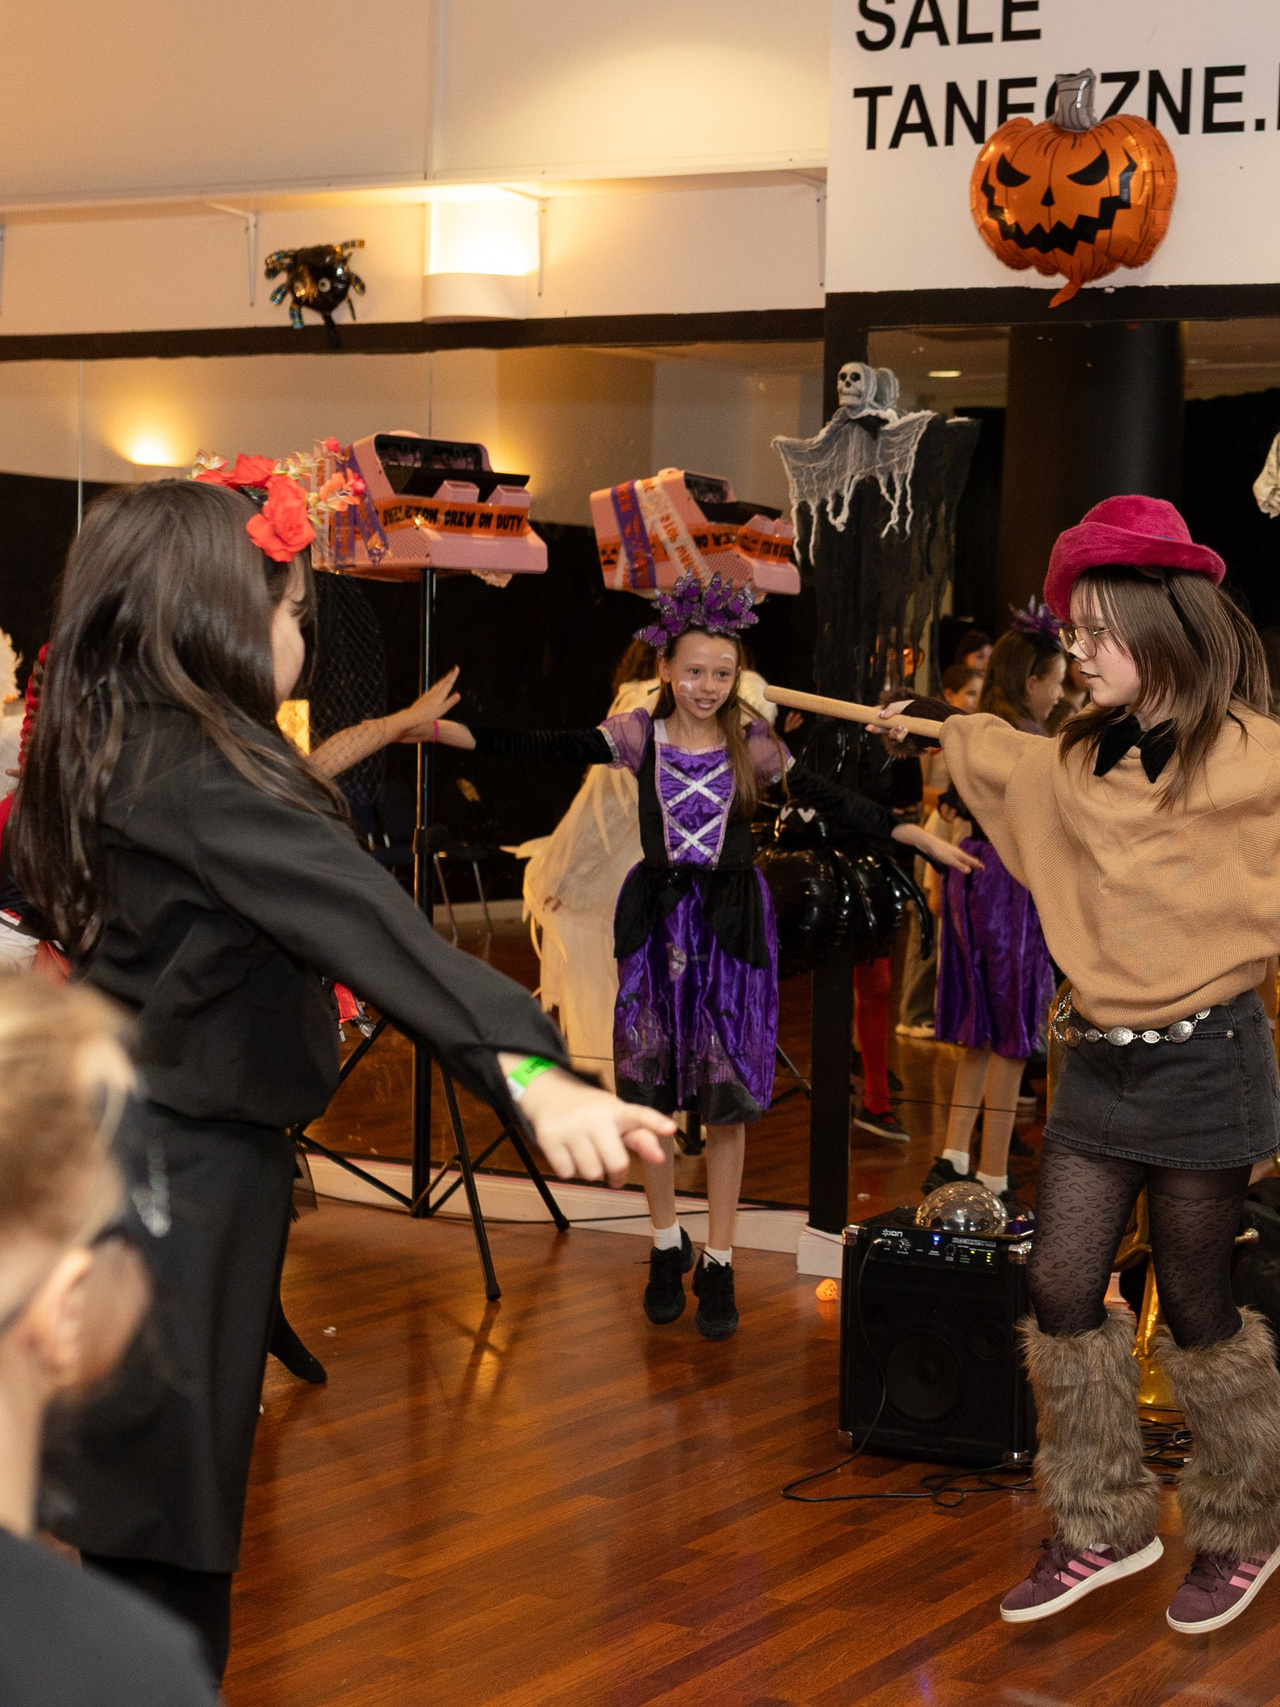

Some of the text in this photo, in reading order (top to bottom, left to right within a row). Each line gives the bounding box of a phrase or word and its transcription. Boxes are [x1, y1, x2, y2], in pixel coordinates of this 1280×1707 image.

[855, 0, 1042, 51] SALE
[444, 509, 475, 528] CREW
[479, 512, 493, 529] ON
[496, 513, 524, 532] DUTY
